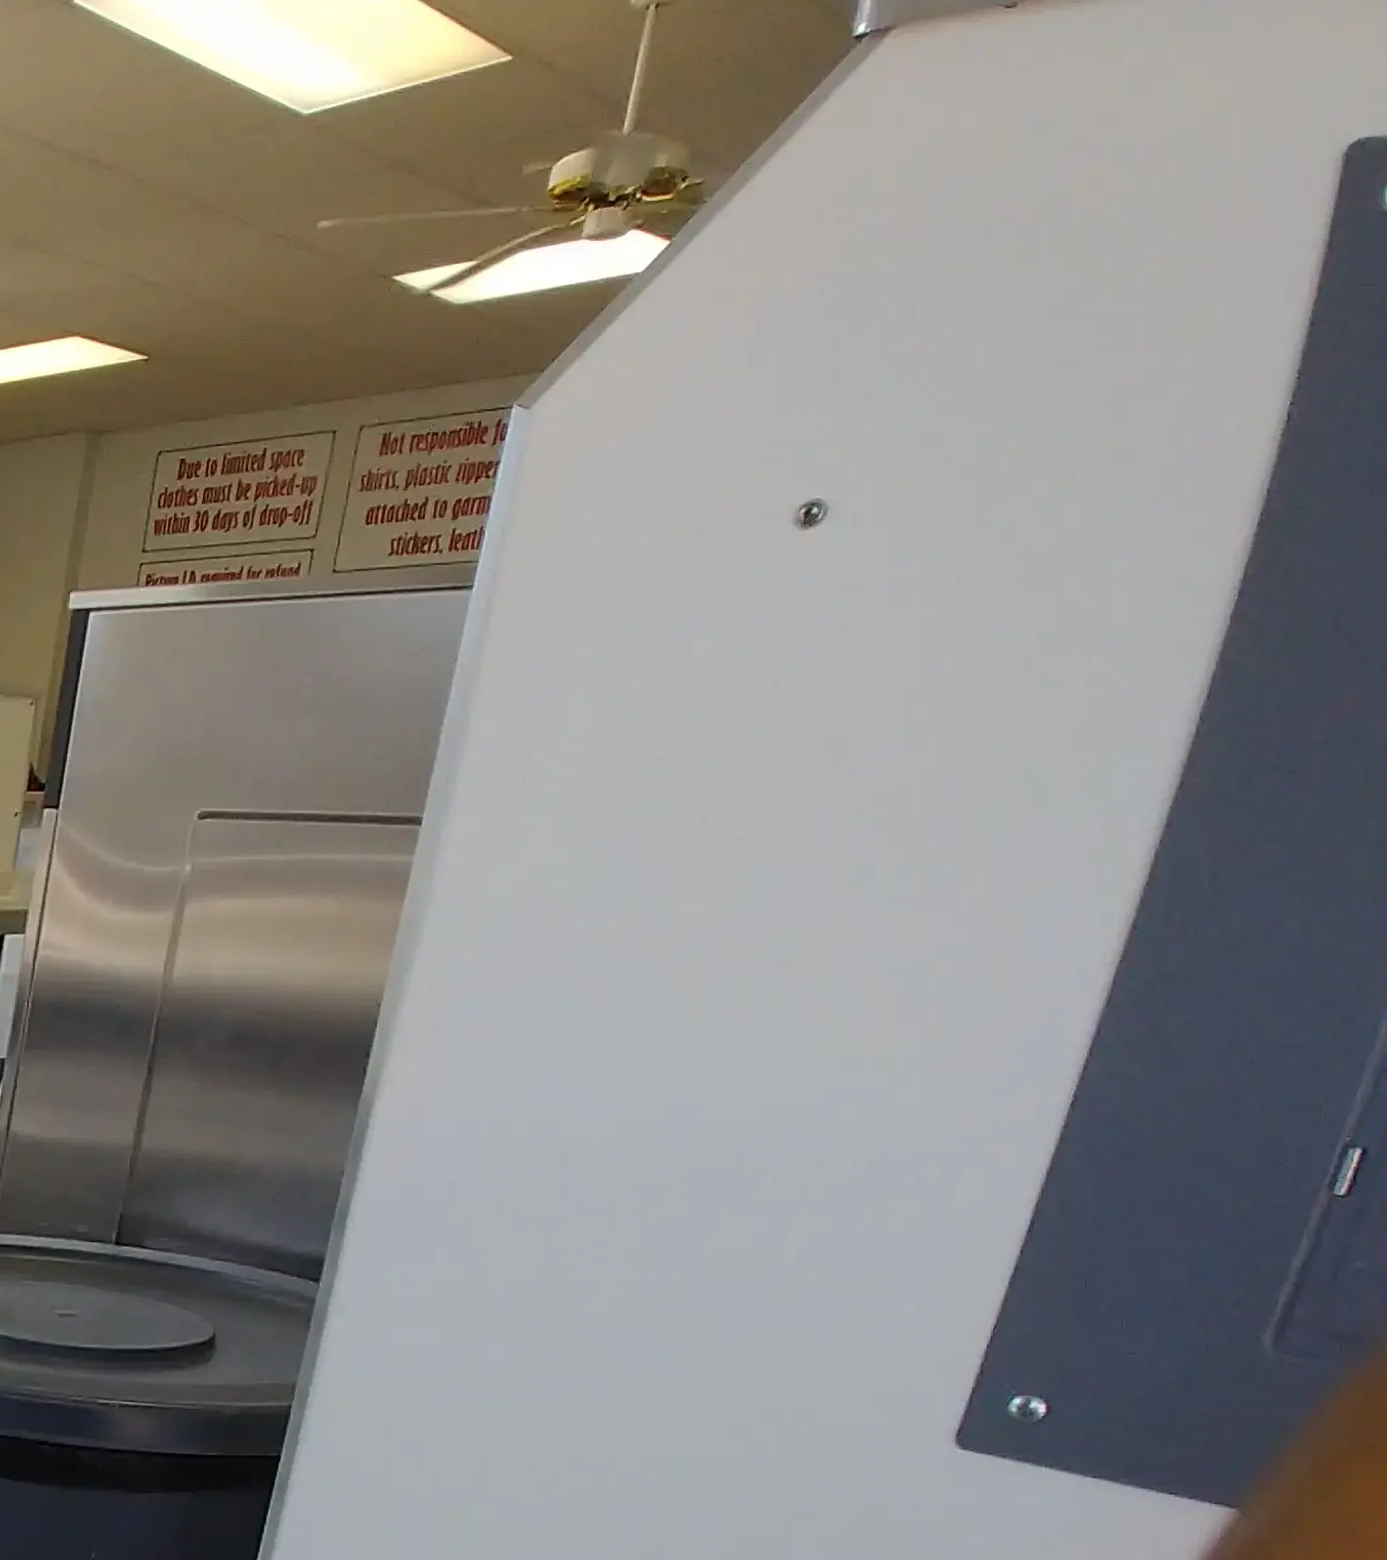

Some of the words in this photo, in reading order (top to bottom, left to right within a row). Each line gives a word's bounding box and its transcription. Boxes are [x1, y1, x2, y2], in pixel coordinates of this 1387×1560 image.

[379, 431, 407, 456] Not
[408, 420, 489, 454] responsible
[491, 418, 508, 447] fo
[176, 457, 202, 481] Due
[205, 457, 218, 478] to
[220, 447, 268, 476] limited
[268, 449, 306, 474] space
[359, 467, 400, 492] shirts,
[403, 459, 453, 492] plastic
[454, 457, 500, 485] zipper
[157, 484, 199, 510] clothes
[201, 482, 233, 505] must
[235, 477, 252, 502] be
[253, 472, 318, 503] picked-up
[153, 507, 191, 537] within
[192, 509, 210, 533] 30
[211, 506, 240, 534] days
[242, 503, 258, 530] of
[258, 499, 314, 528] drop-off
[365, 497, 429, 526] attached
[432, 499, 448, 519] to
[451, 495, 492, 521] garm
